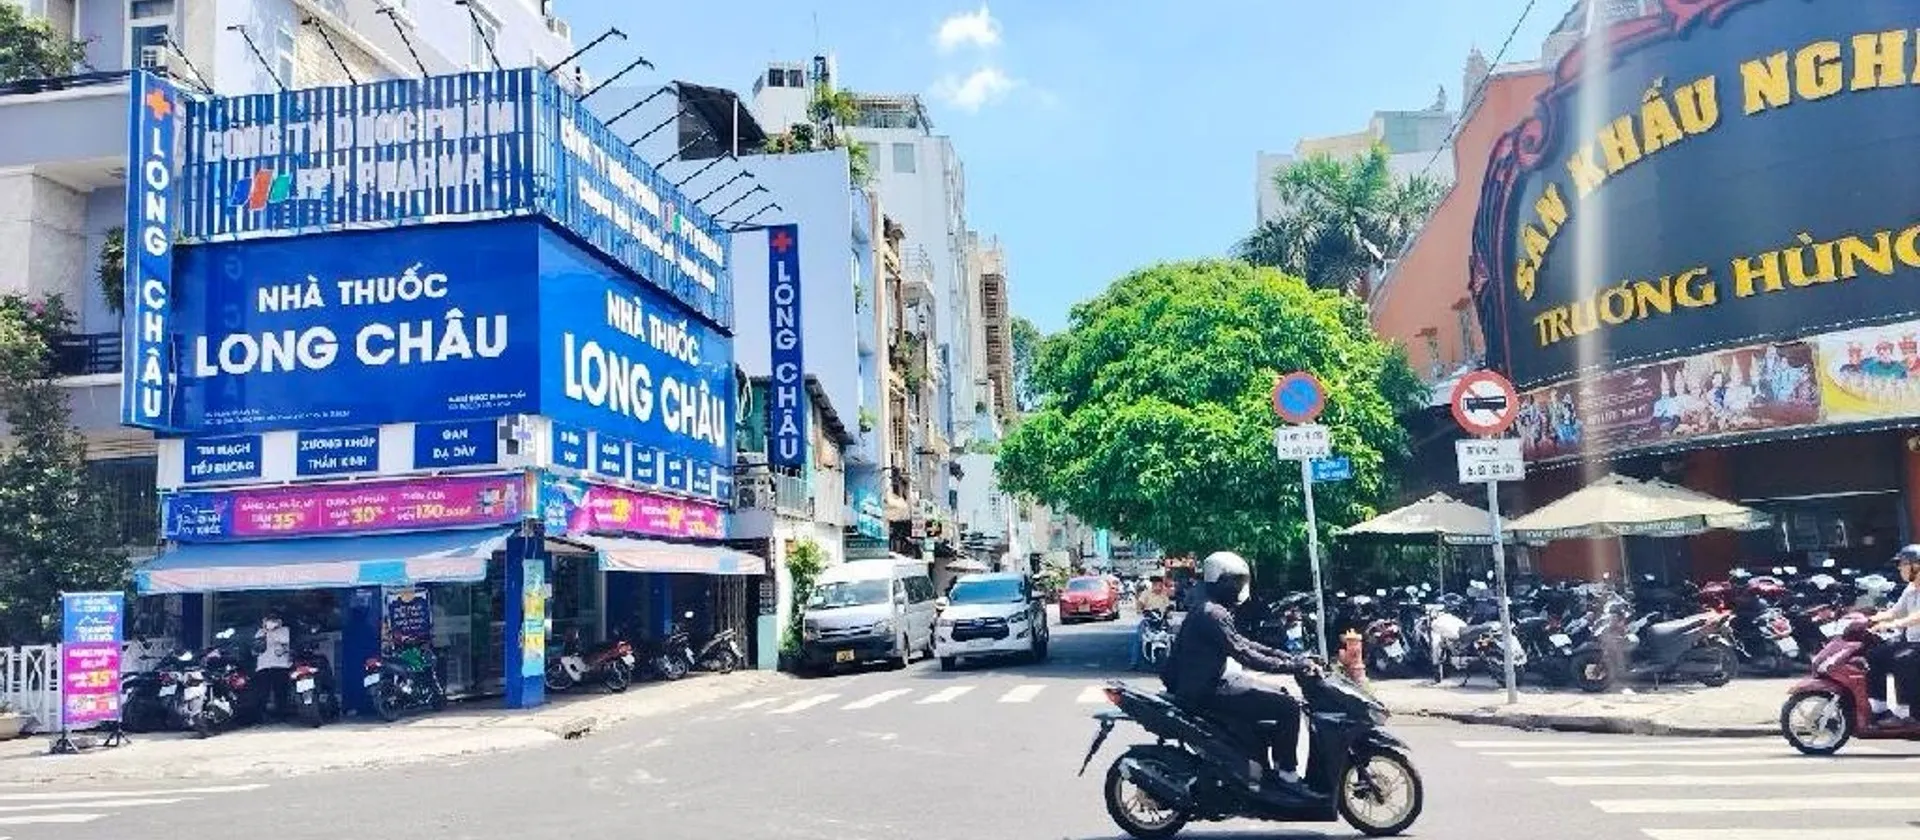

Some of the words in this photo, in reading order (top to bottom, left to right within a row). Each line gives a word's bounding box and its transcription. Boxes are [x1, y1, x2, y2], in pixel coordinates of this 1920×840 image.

[1567, 75, 1719, 199] KHẤU
[1740, 28, 1920, 116] NGH
[143, 127, 169, 256] LONG
[258, 274, 324, 313] NHÀ
[338, 262, 448, 306] THUỐC
[607, 289, 646, 343] NHÀ
[649, 314, 700, 367] THUỐC
[774, 260, 798, 351] LONG
[141, 279, 167, 418] CHÂU
[196, 325, 339, 377] LONG
[356, 307, 508, 366] CHÂU
[563, 331, 653, 423] LONG
[660, 375, 726, 449] CHÂU
[775, 362, 800, 460] CHÂU
